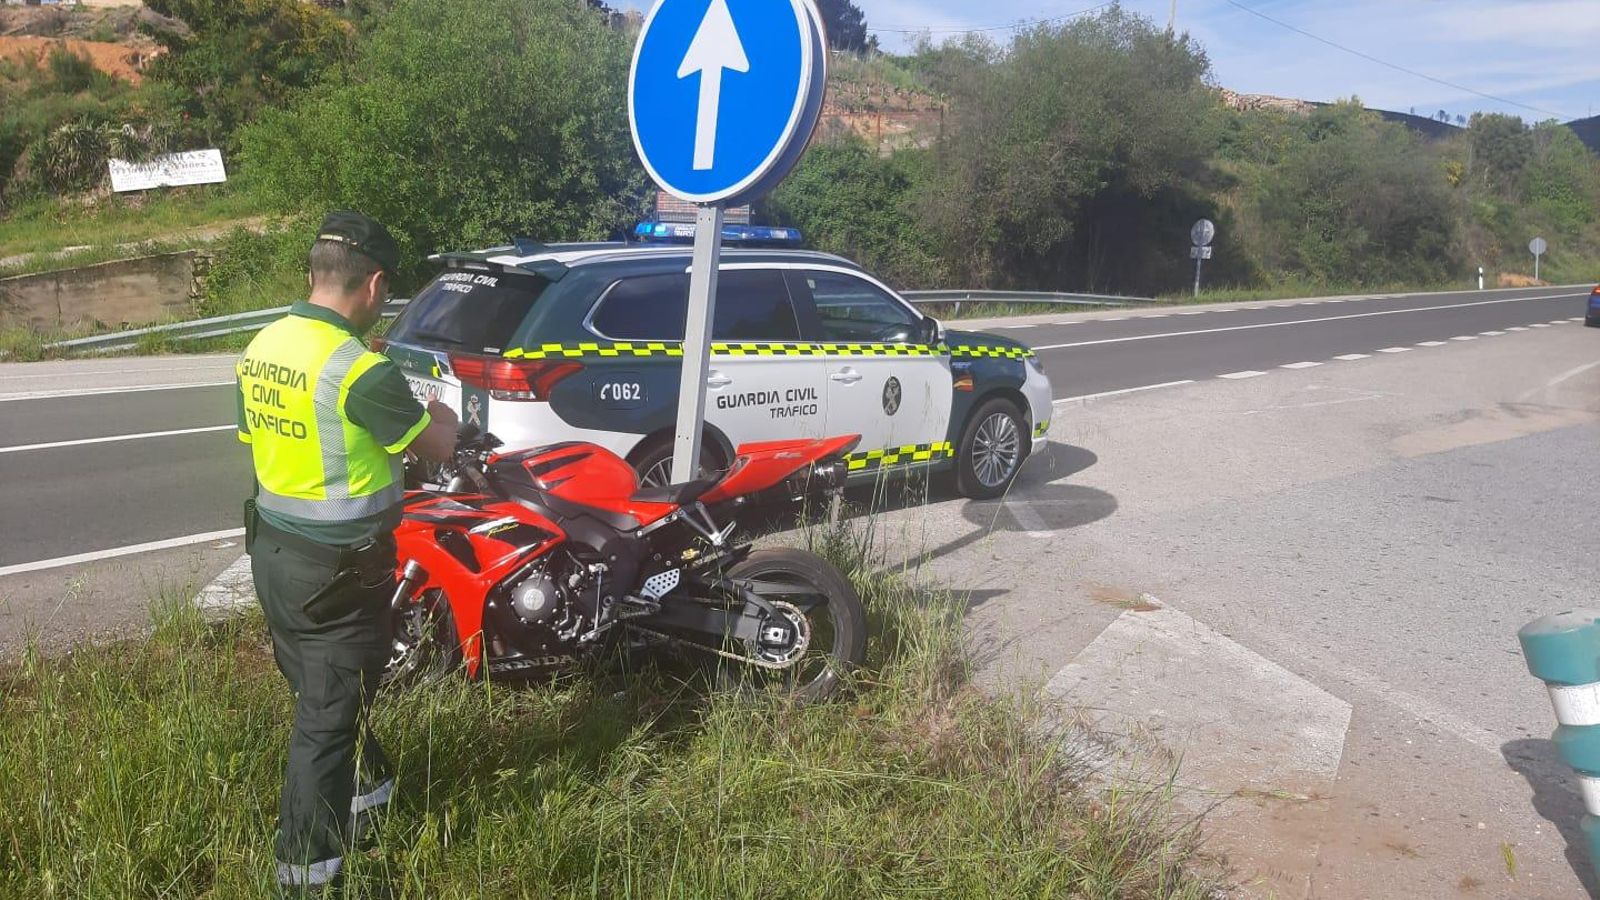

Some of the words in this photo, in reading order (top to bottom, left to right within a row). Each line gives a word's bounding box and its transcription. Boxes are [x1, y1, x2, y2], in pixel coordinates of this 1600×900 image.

[242, 358, 307, 392] GUARDIA
[252, 383, 286, 410] CIVIL
[612, 382, 641, 400] 062
[717, 390, 780, 409] GUARDIA
[786, 387, 818, 402] CIVIL
[246, 408, 307, 440] TRÁFICO
